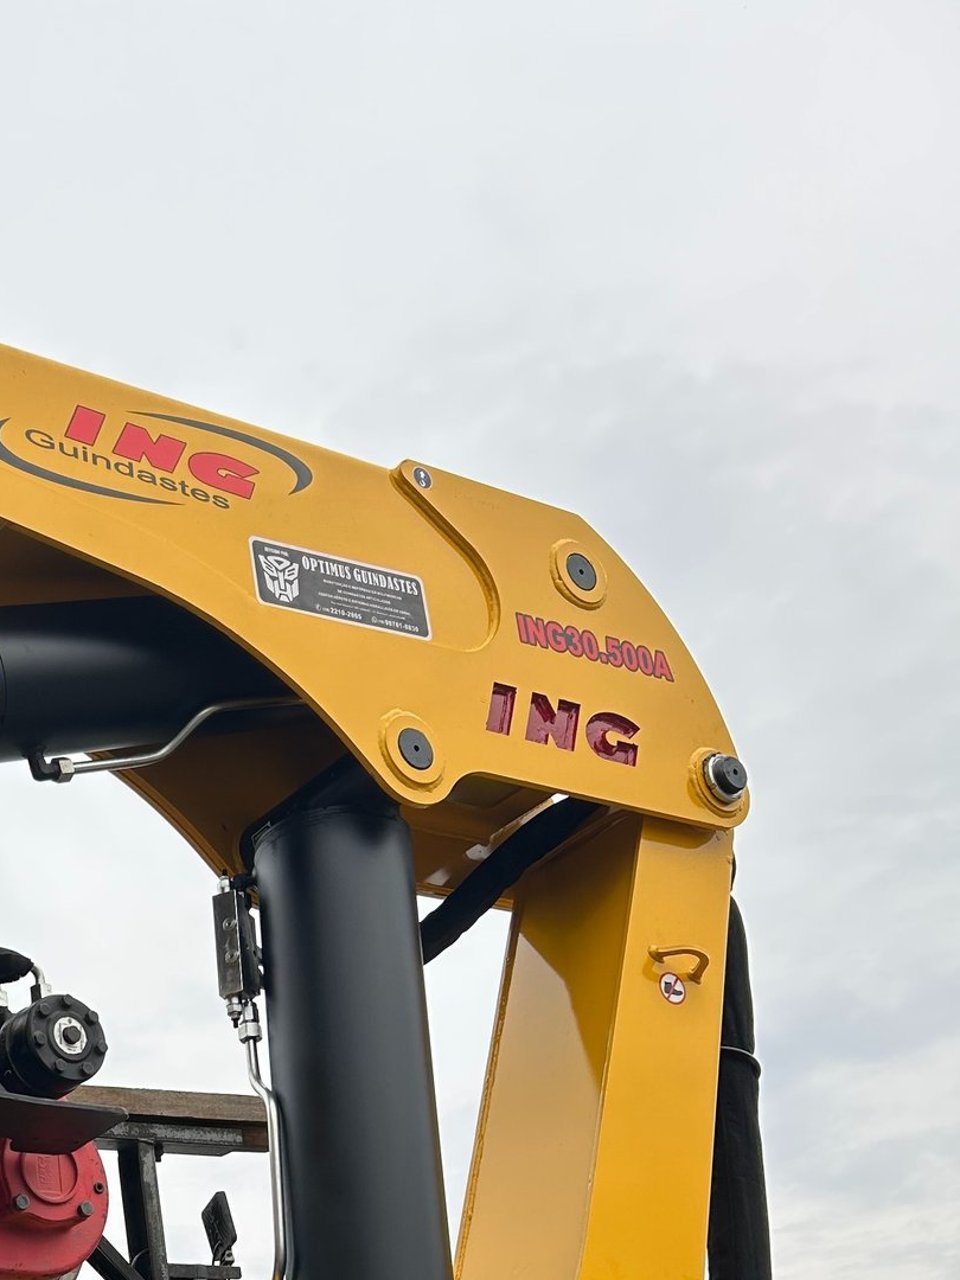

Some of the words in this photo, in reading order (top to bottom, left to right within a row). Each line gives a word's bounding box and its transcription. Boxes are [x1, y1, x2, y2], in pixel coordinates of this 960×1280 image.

[24, 428, 230, 509] Guindastes
[63, 404, 260, 500] ING
[301, 555, 352, 580] OPTIMUS
[353, 568, 419, 596] GUINDASTES
[515, 612, 674, 683] ING30.500A
[486, 681, 641, 767] ING
